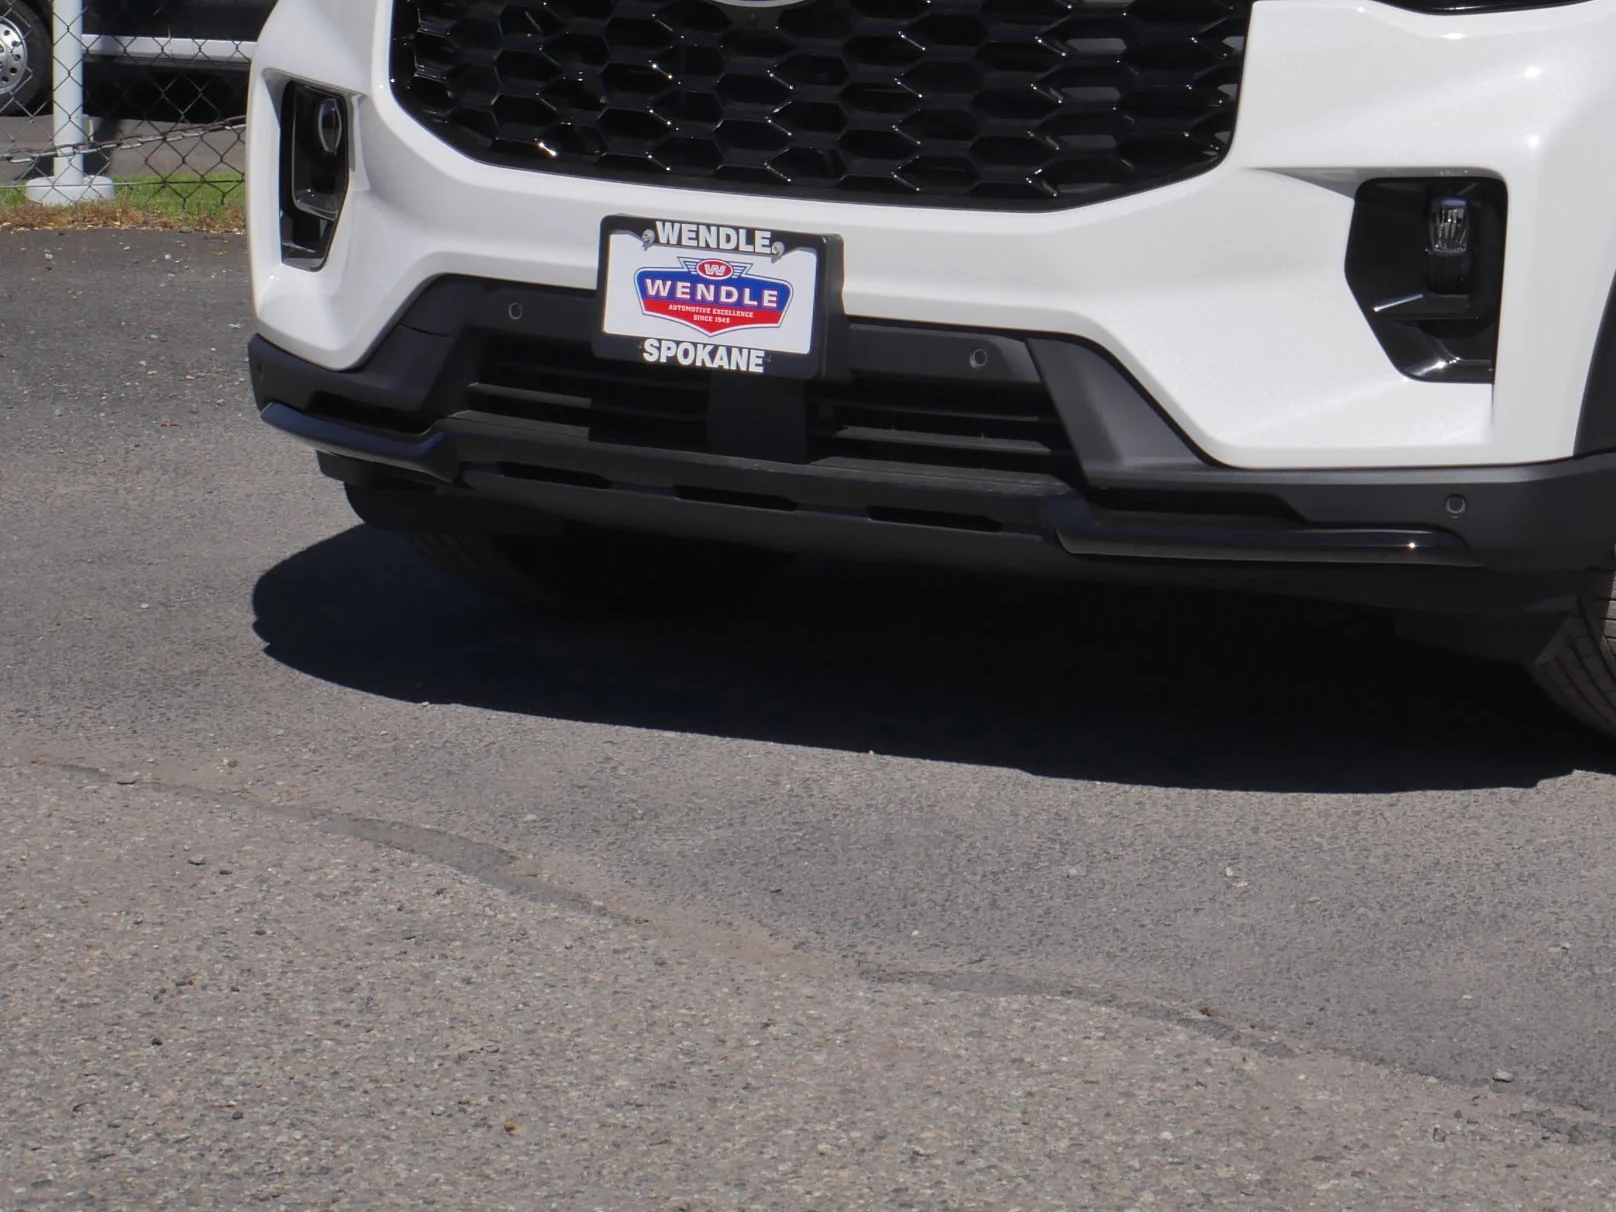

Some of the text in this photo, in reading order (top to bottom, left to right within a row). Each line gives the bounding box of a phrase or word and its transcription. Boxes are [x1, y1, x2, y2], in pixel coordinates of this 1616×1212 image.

[655, 221, 772, 254] WENDLE
[644, 278, 779, 308] WENDLE
[668, 304, 754, 319] AUTOMOTIVE EXCELLENCE
[693, 314, 731, 324] SINCE 1943
[643, 339, 766, 373] SPOKANE
